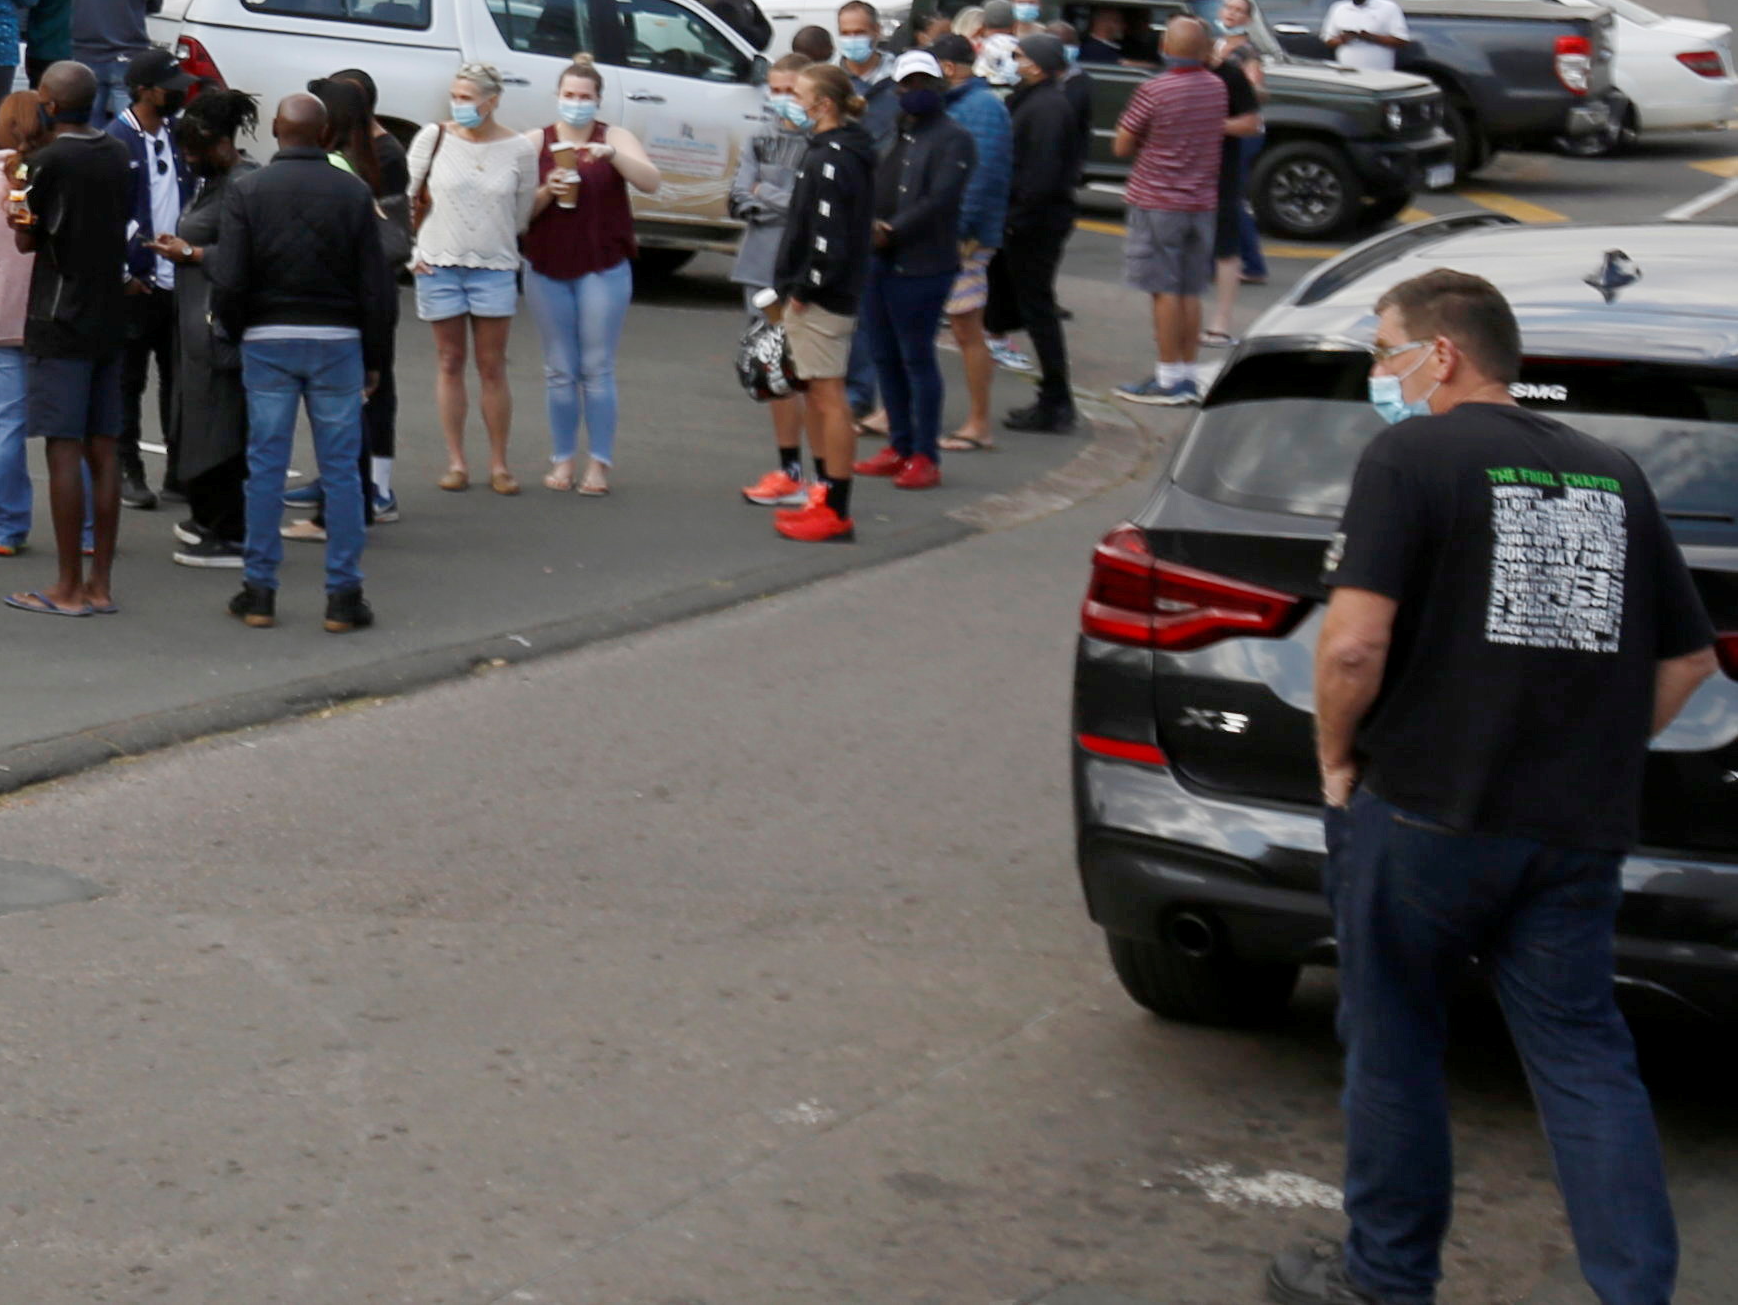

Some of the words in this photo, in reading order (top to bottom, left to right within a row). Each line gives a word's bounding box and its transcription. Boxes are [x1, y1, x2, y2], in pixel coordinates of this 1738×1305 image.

[1508, 382, 1568, 401] SMG
[1560, 471, 1623, 494] CHAPTER
[1177, 706, 1249, 733] X3
